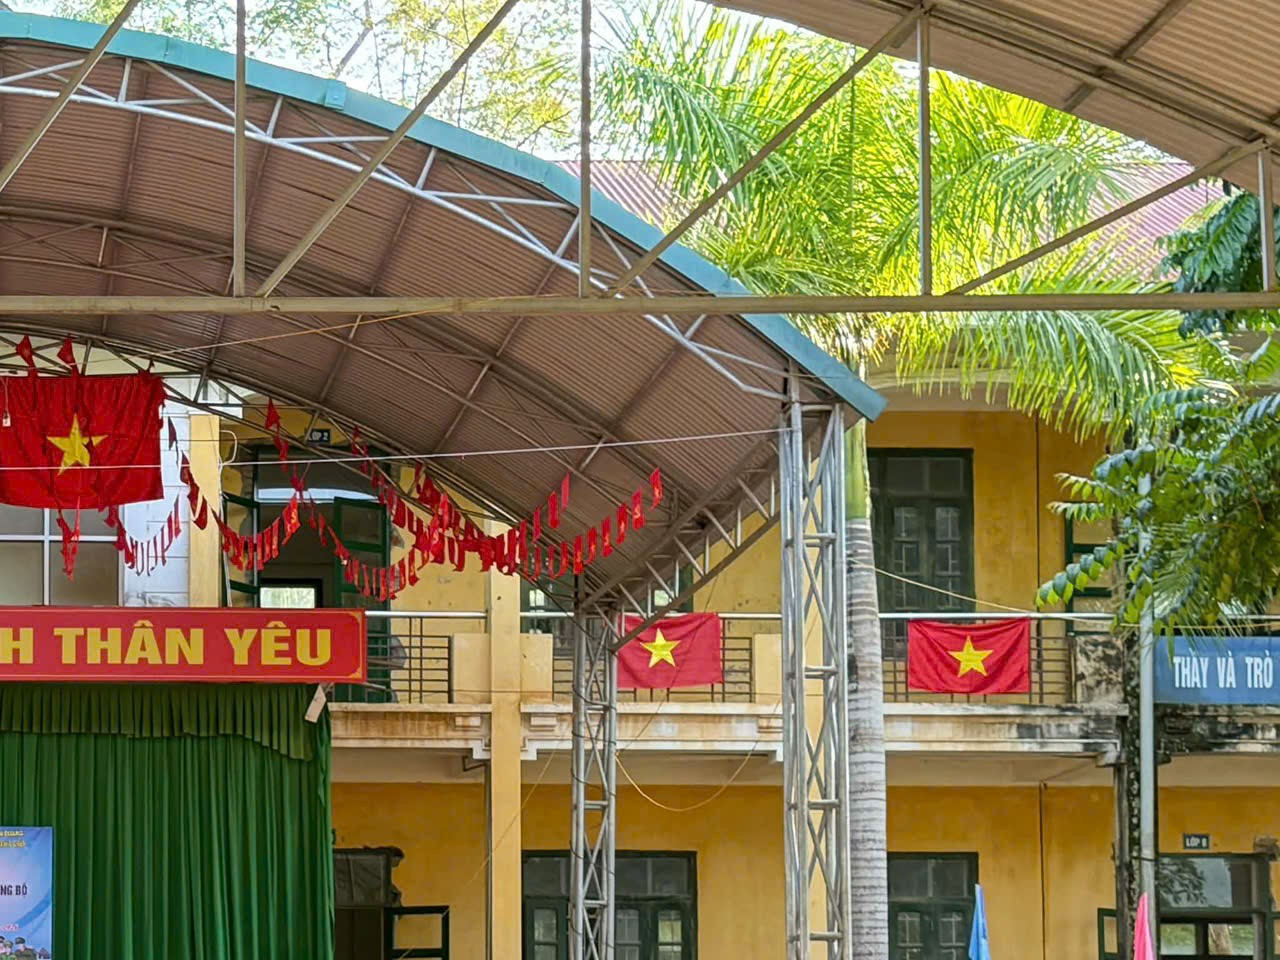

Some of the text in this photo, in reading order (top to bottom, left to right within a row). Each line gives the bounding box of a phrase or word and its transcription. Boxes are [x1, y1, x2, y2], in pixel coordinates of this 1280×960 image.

[54, 619, 205, 665] THÂN
[223, 620, 332, 665] YÊU
[1217, 650, 1236, 688] VÀ
[1245, 649, 1273, 688] TRÒ
[15, 882, 28, 899] BỘ
